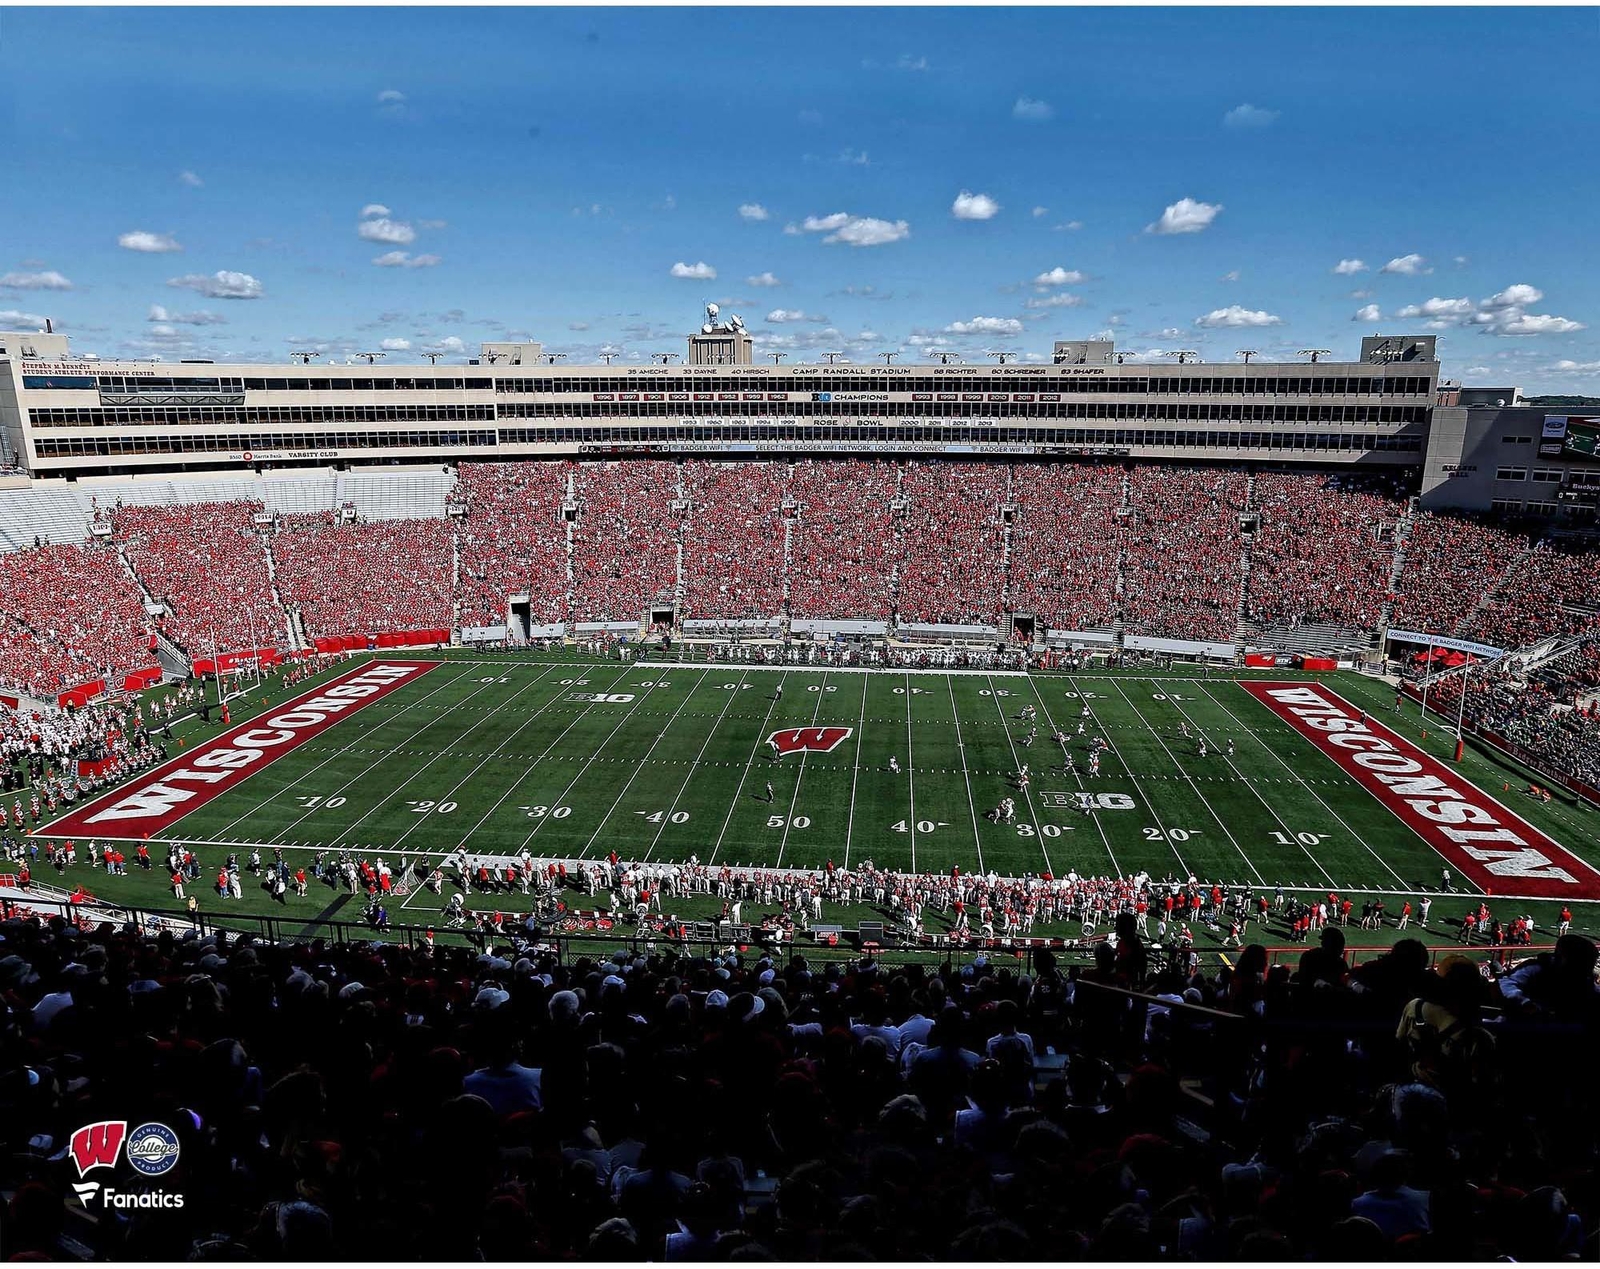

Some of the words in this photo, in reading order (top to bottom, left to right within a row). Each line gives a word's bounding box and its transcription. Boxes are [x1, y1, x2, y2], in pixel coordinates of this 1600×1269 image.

[1389, 631, 1417, 641] CONNECT
[1439, 639, 1463, 648] BADGER
[83, 664, 420, 825] WISCONSIN
[1265, 687, 1581, 884] WISCONSIN
[299, 796, 347, 809] 10
[411, 800, 458, 814] 20
[526, 805, 573, 819] 30
[644, 810, 690, 824] 40
[766, 815, 811, 829] 50
[890, 819, 936, 833] 40
[1016, 823, 1062, 838] 30
[1142, 827, 1191, 842] 20
[1268, 830, 1320, 846] 10
